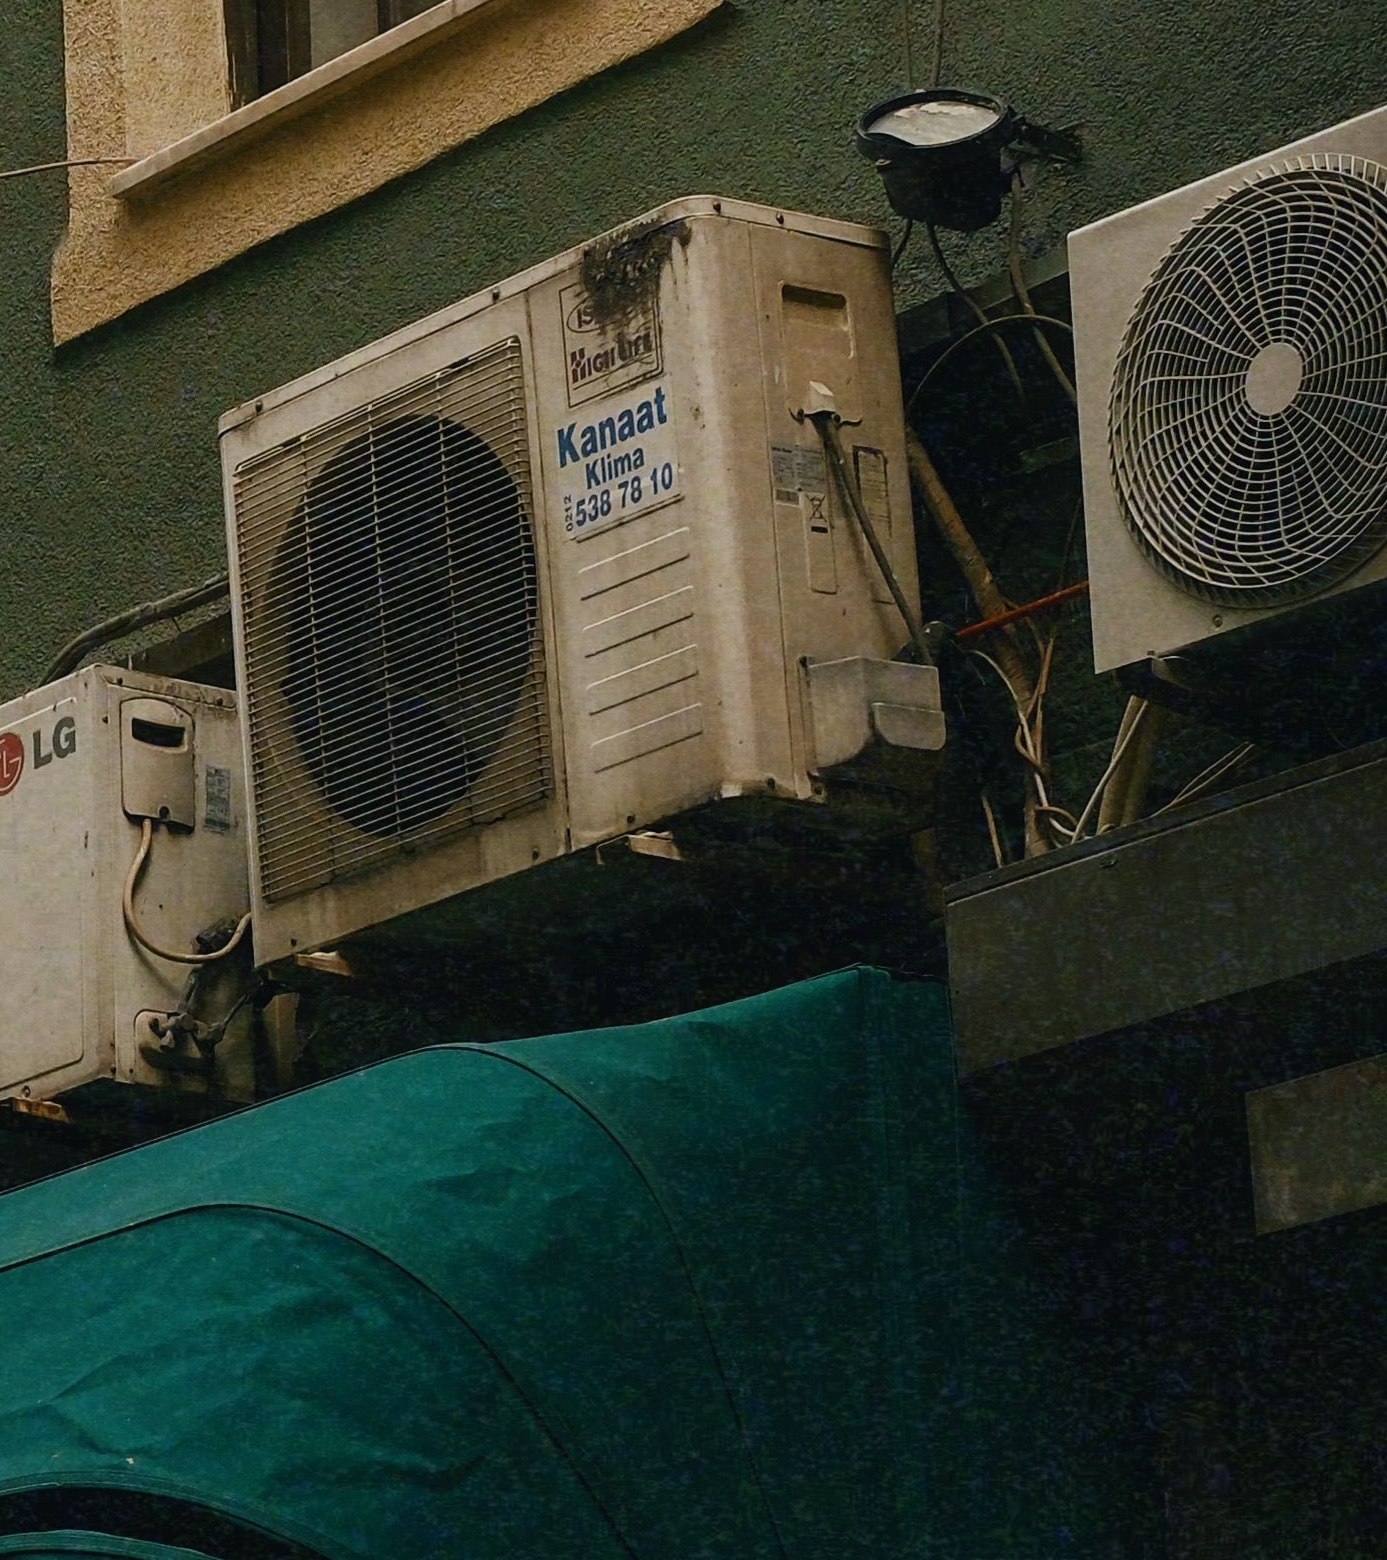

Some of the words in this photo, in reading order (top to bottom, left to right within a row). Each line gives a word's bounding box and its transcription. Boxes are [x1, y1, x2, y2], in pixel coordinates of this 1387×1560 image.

[557, 386, 668, 468] Kanaat
[575, 489, 612, 527] 538
[618, 475, 643, 508] 78
[650, 462, 673, 495] 10
[585, 447, 645, 489] Klima
[564, 493, 573, 532] 0212
[33, 716, 76, 769] LG
